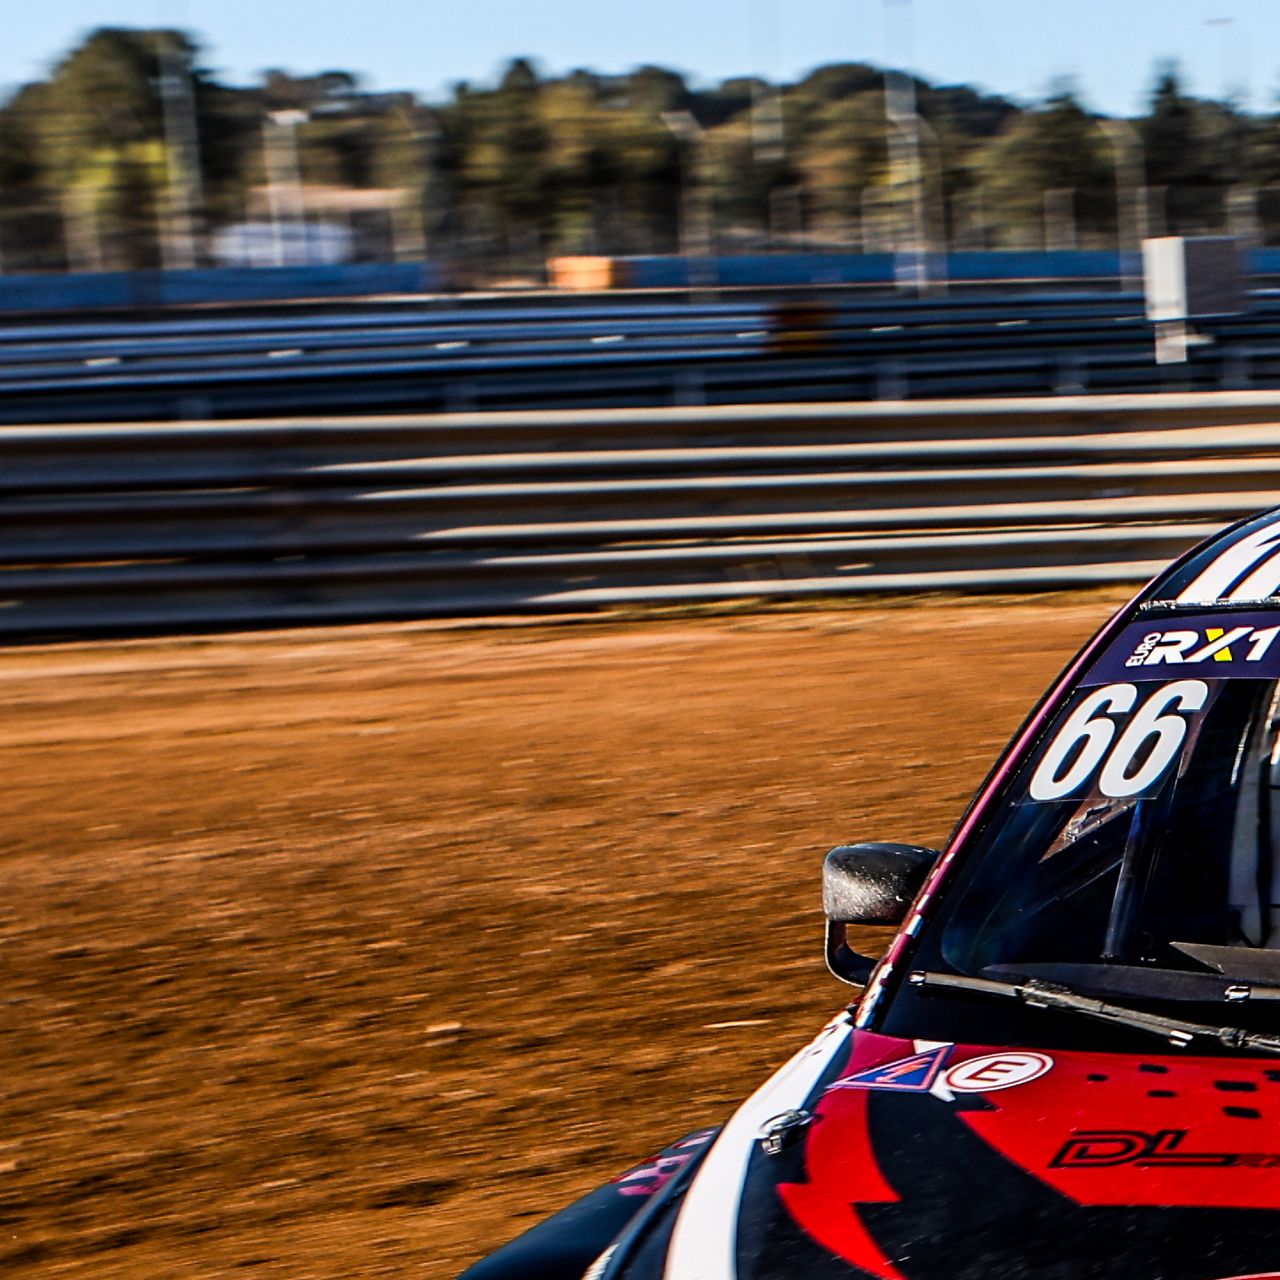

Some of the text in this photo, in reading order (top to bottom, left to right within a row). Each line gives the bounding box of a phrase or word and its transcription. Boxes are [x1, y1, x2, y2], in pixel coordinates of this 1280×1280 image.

[1125, 625, 1280, 667] EURO RX1
[1029, 679, 1209, 801] 66
[965, 1060, 1028, 1082] E
